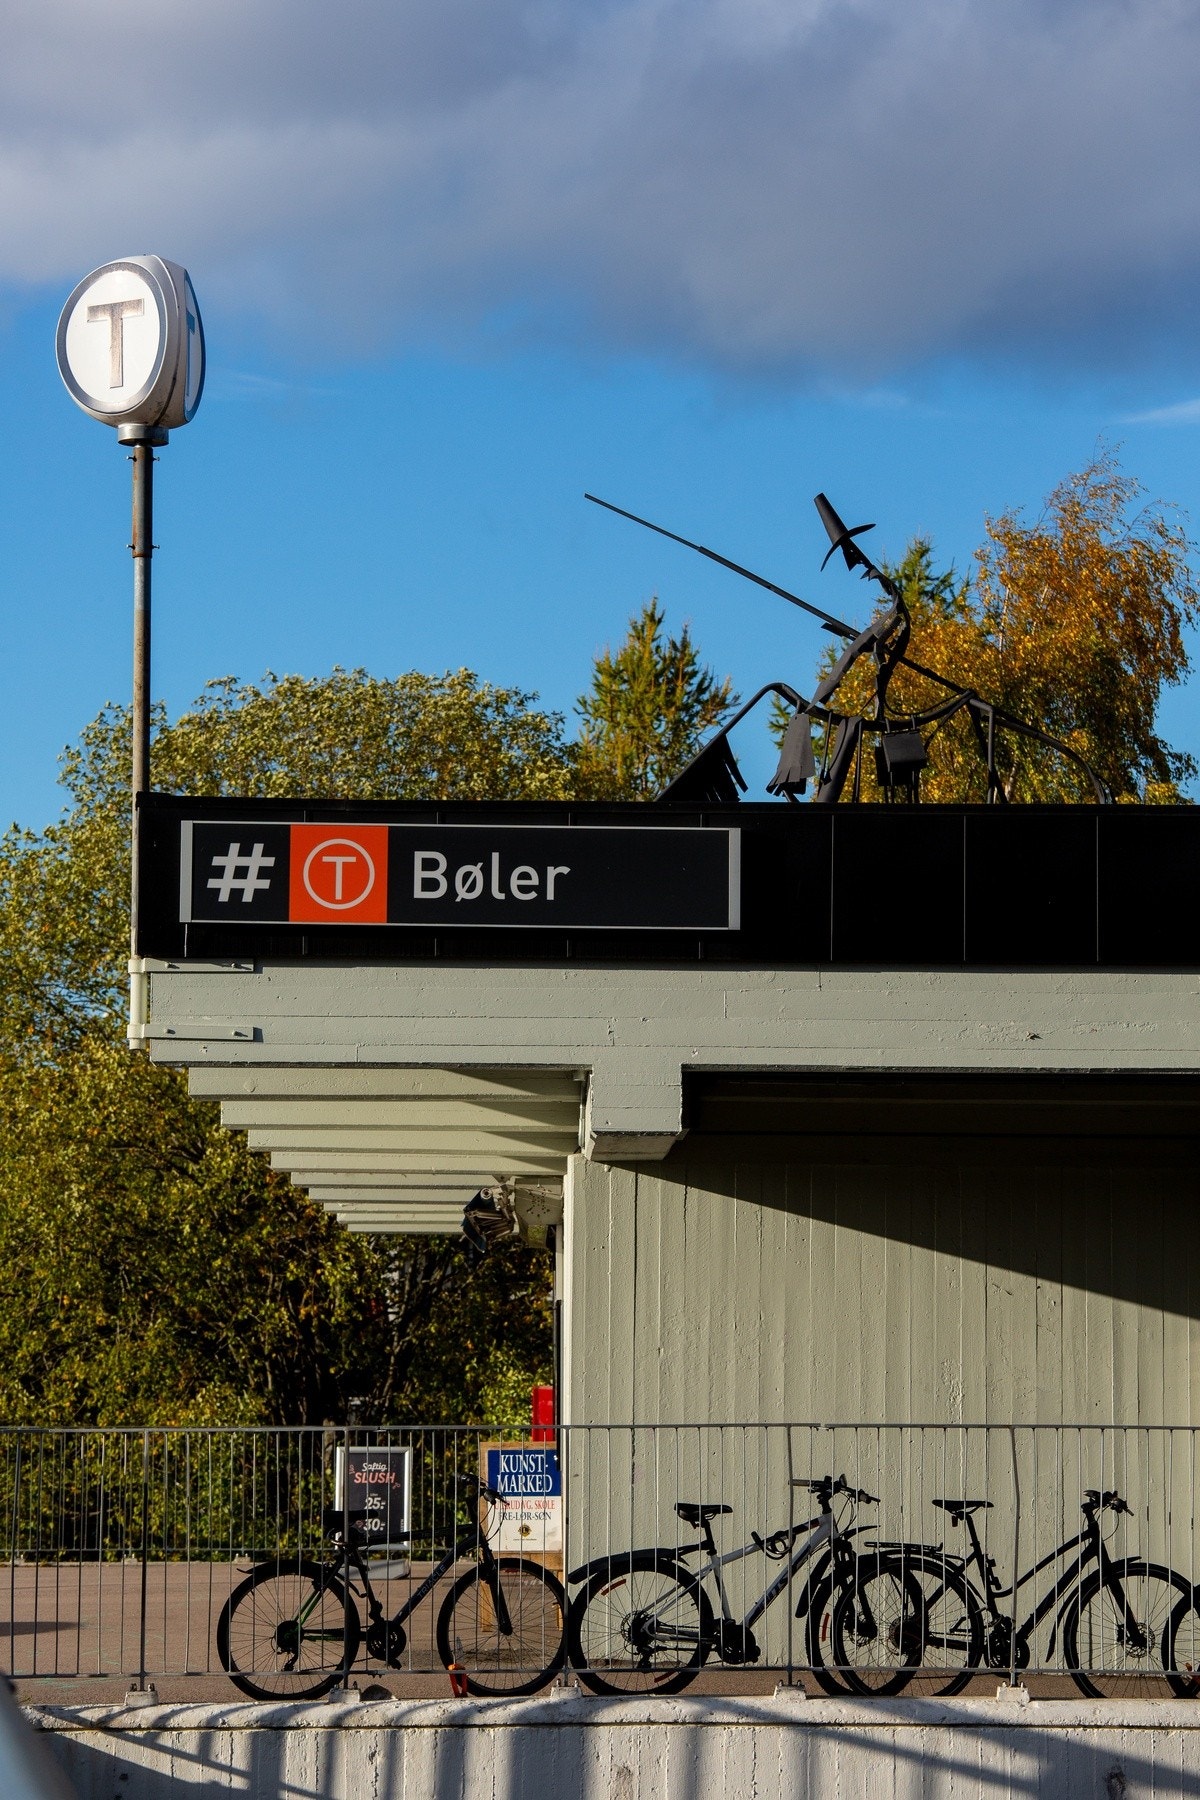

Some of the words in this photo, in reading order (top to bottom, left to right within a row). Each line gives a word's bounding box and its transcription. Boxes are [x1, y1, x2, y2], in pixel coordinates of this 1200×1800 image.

[86, 298, 145, 389] T
[413, 851, 571, 902] Bøler
[500, 1454, 549, 1473] KUNST-
[354, 1472, 396, 1483] SLUSH
[497, 1474, 553, 1493] MARKED
